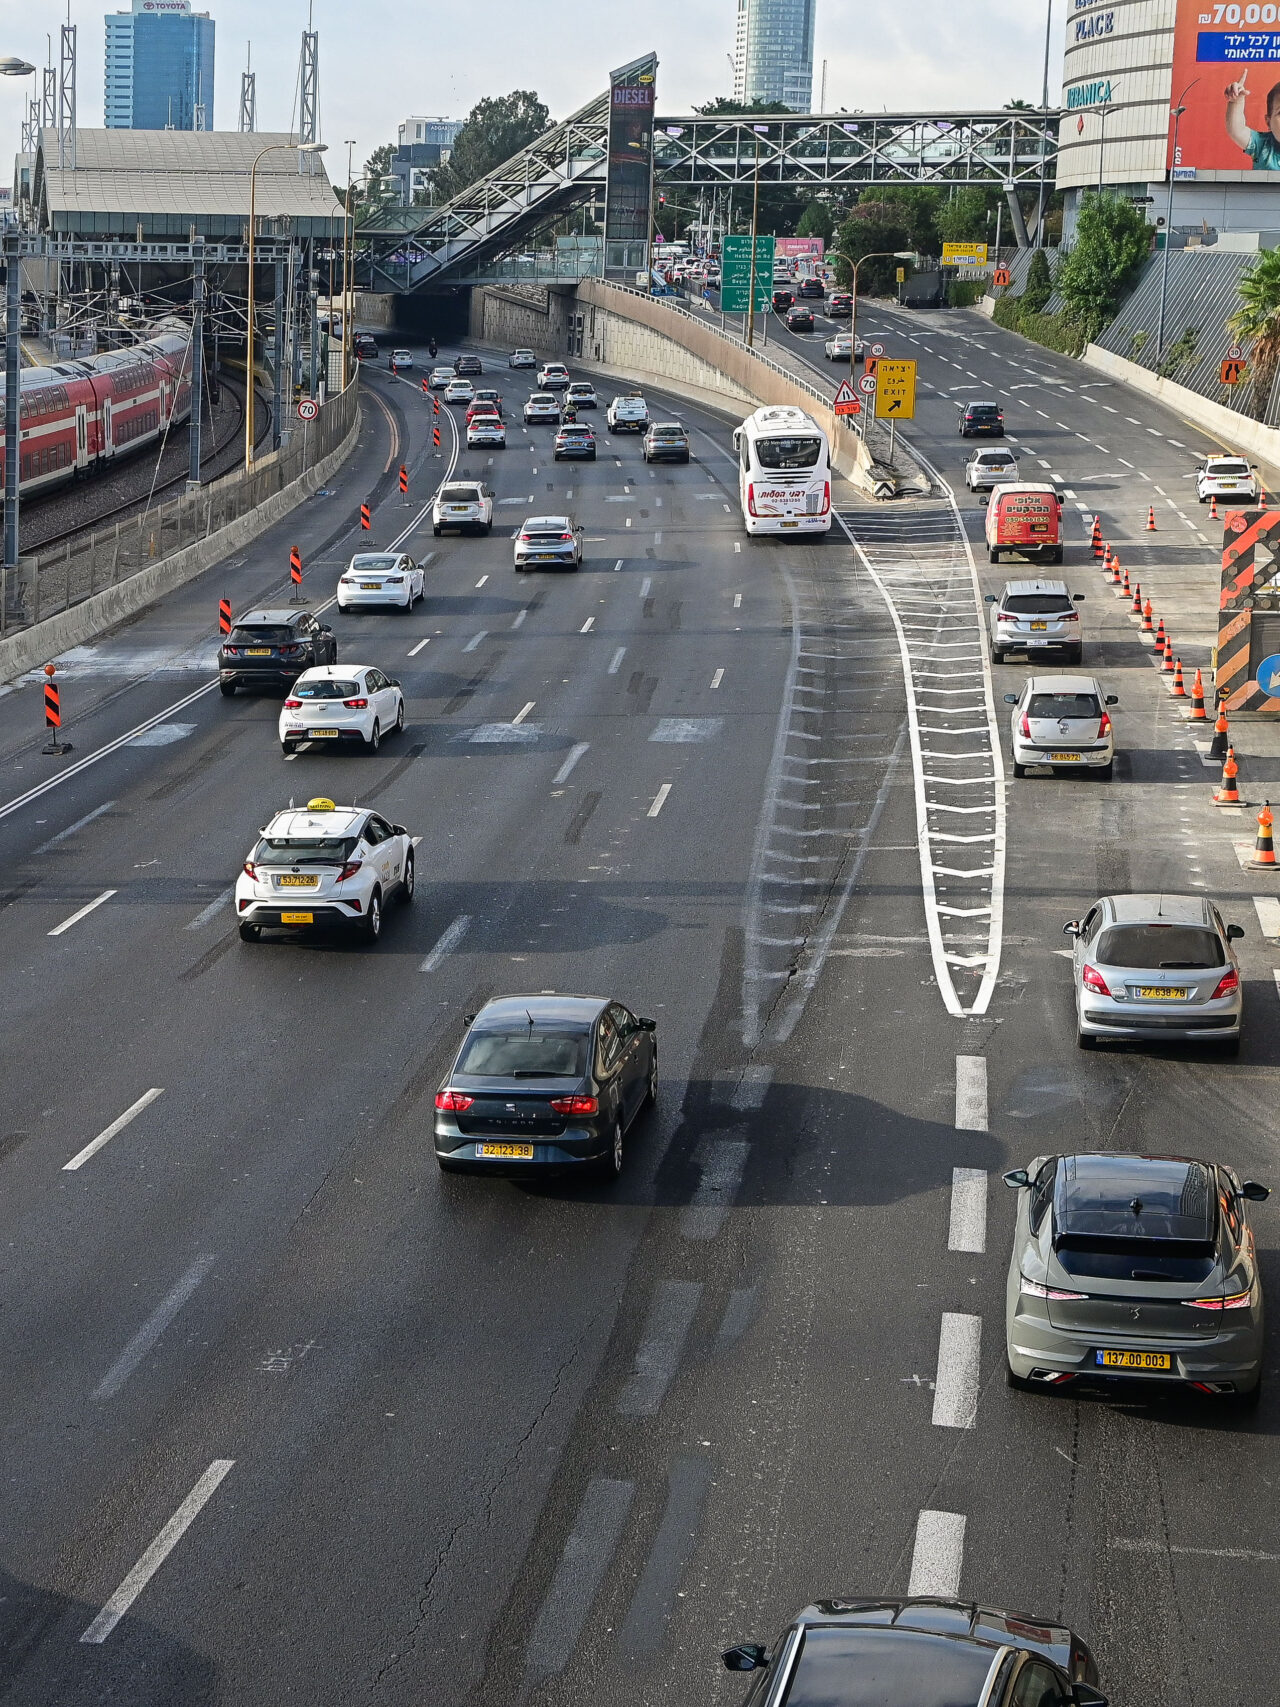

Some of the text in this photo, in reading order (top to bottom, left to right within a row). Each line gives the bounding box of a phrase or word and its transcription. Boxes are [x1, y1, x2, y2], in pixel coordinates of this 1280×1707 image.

[1076, 12, 1114, 41] PLACE
[1249, 35, 1270, 46] לכל
[1225, 48, 1265, 59] הלאומי
[614, 88, 651, 104] DIESEL
[1067, 80, 1112, 109] URBANICA
[882, 365, 911, 373] יציאה
[863, 380, 876, 389] 70
[883, 388, 907, 396] EXIT
[302, 405, 314, 415] 70
